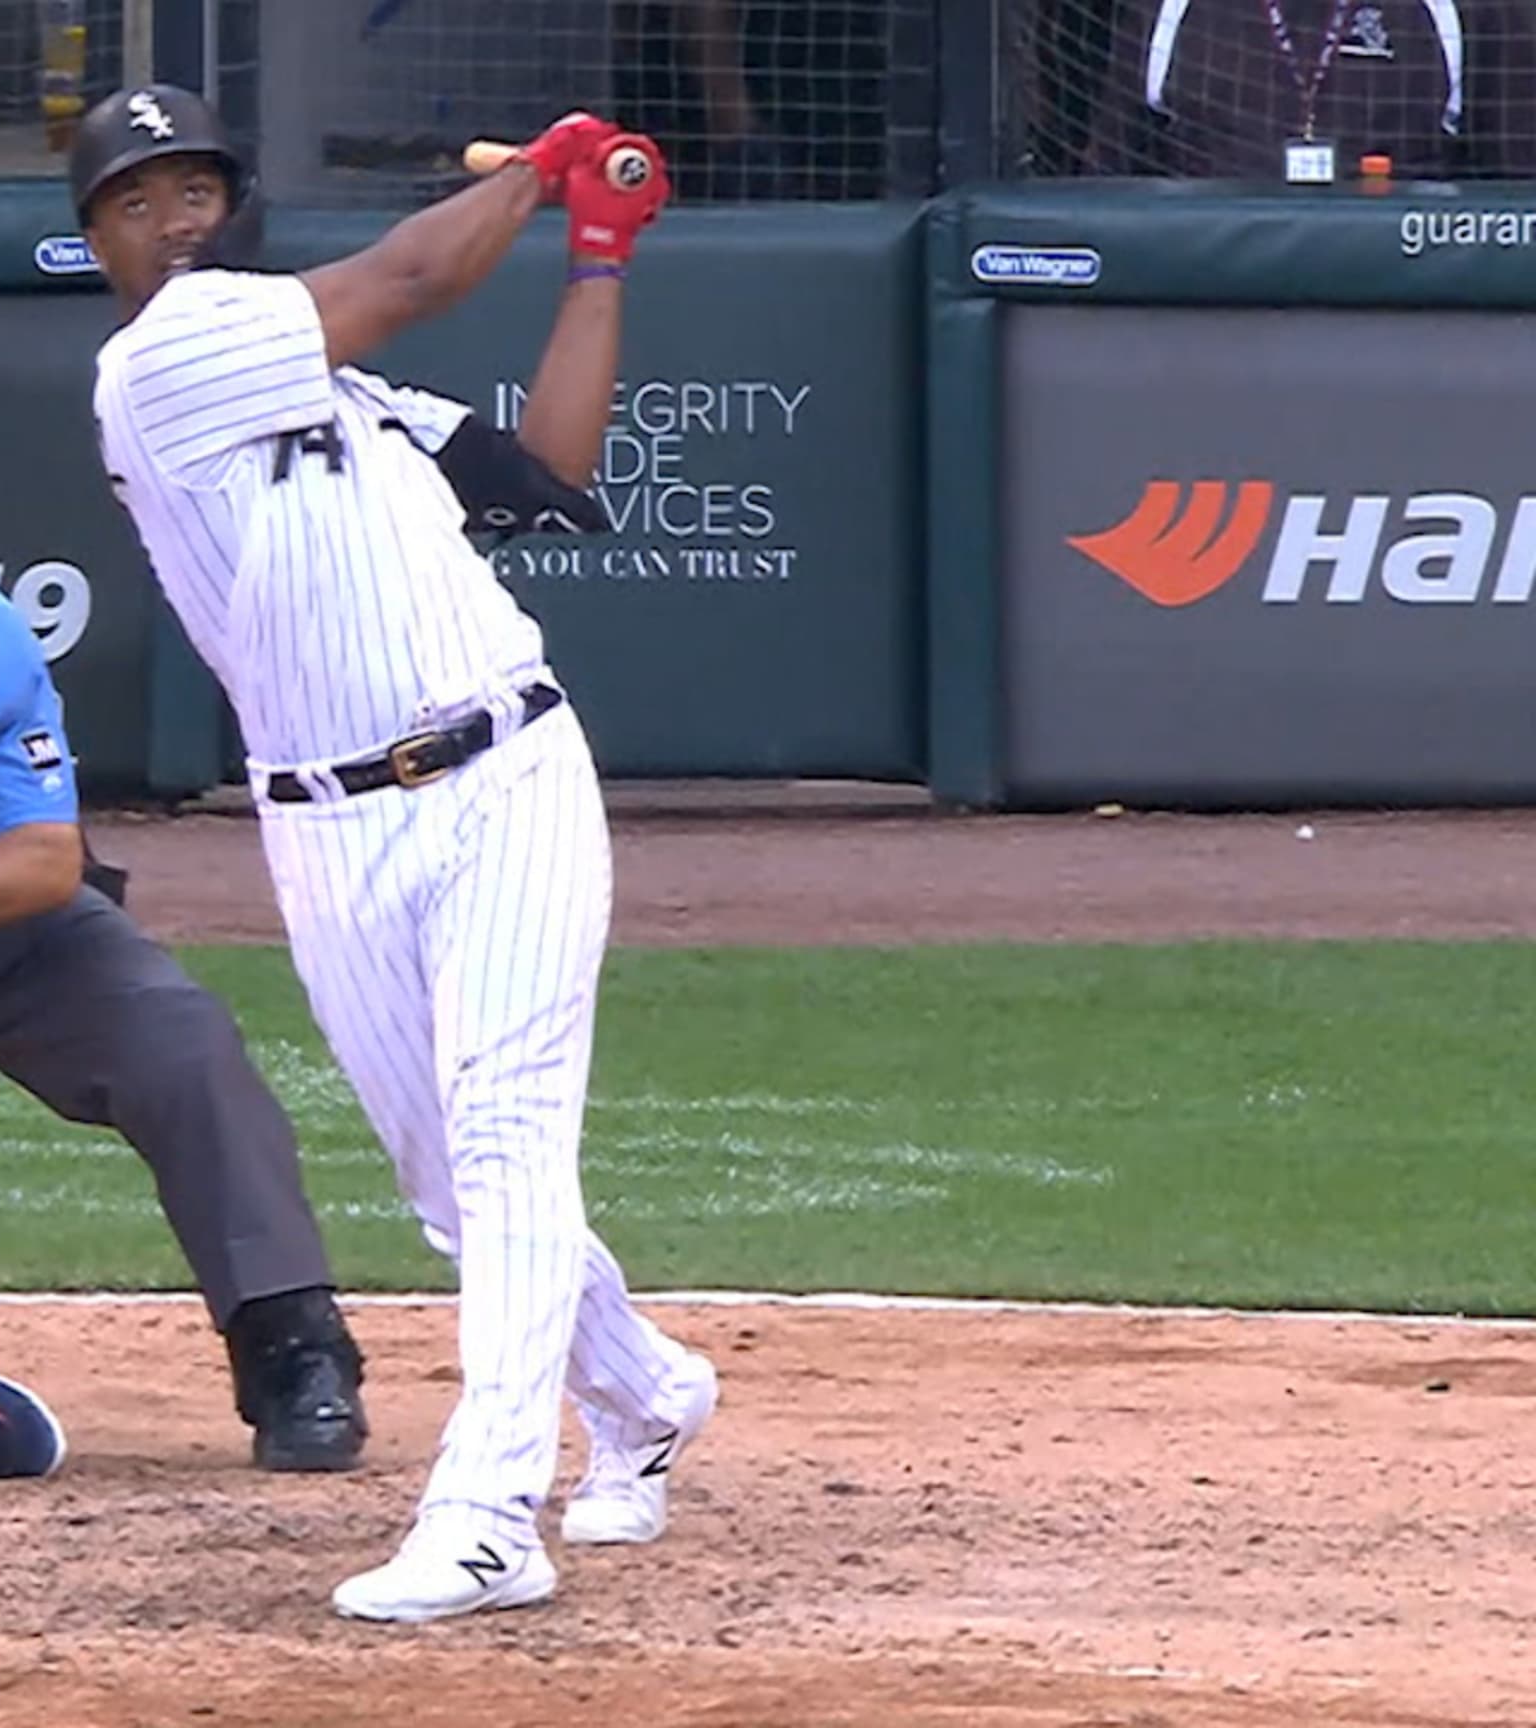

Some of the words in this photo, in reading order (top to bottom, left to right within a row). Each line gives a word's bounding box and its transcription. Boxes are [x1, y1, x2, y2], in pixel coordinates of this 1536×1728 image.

[520, 551, 587, 576] YOU
[603, 551, 670, 577] CAN
[679, 552, 796, 578] TRUST
